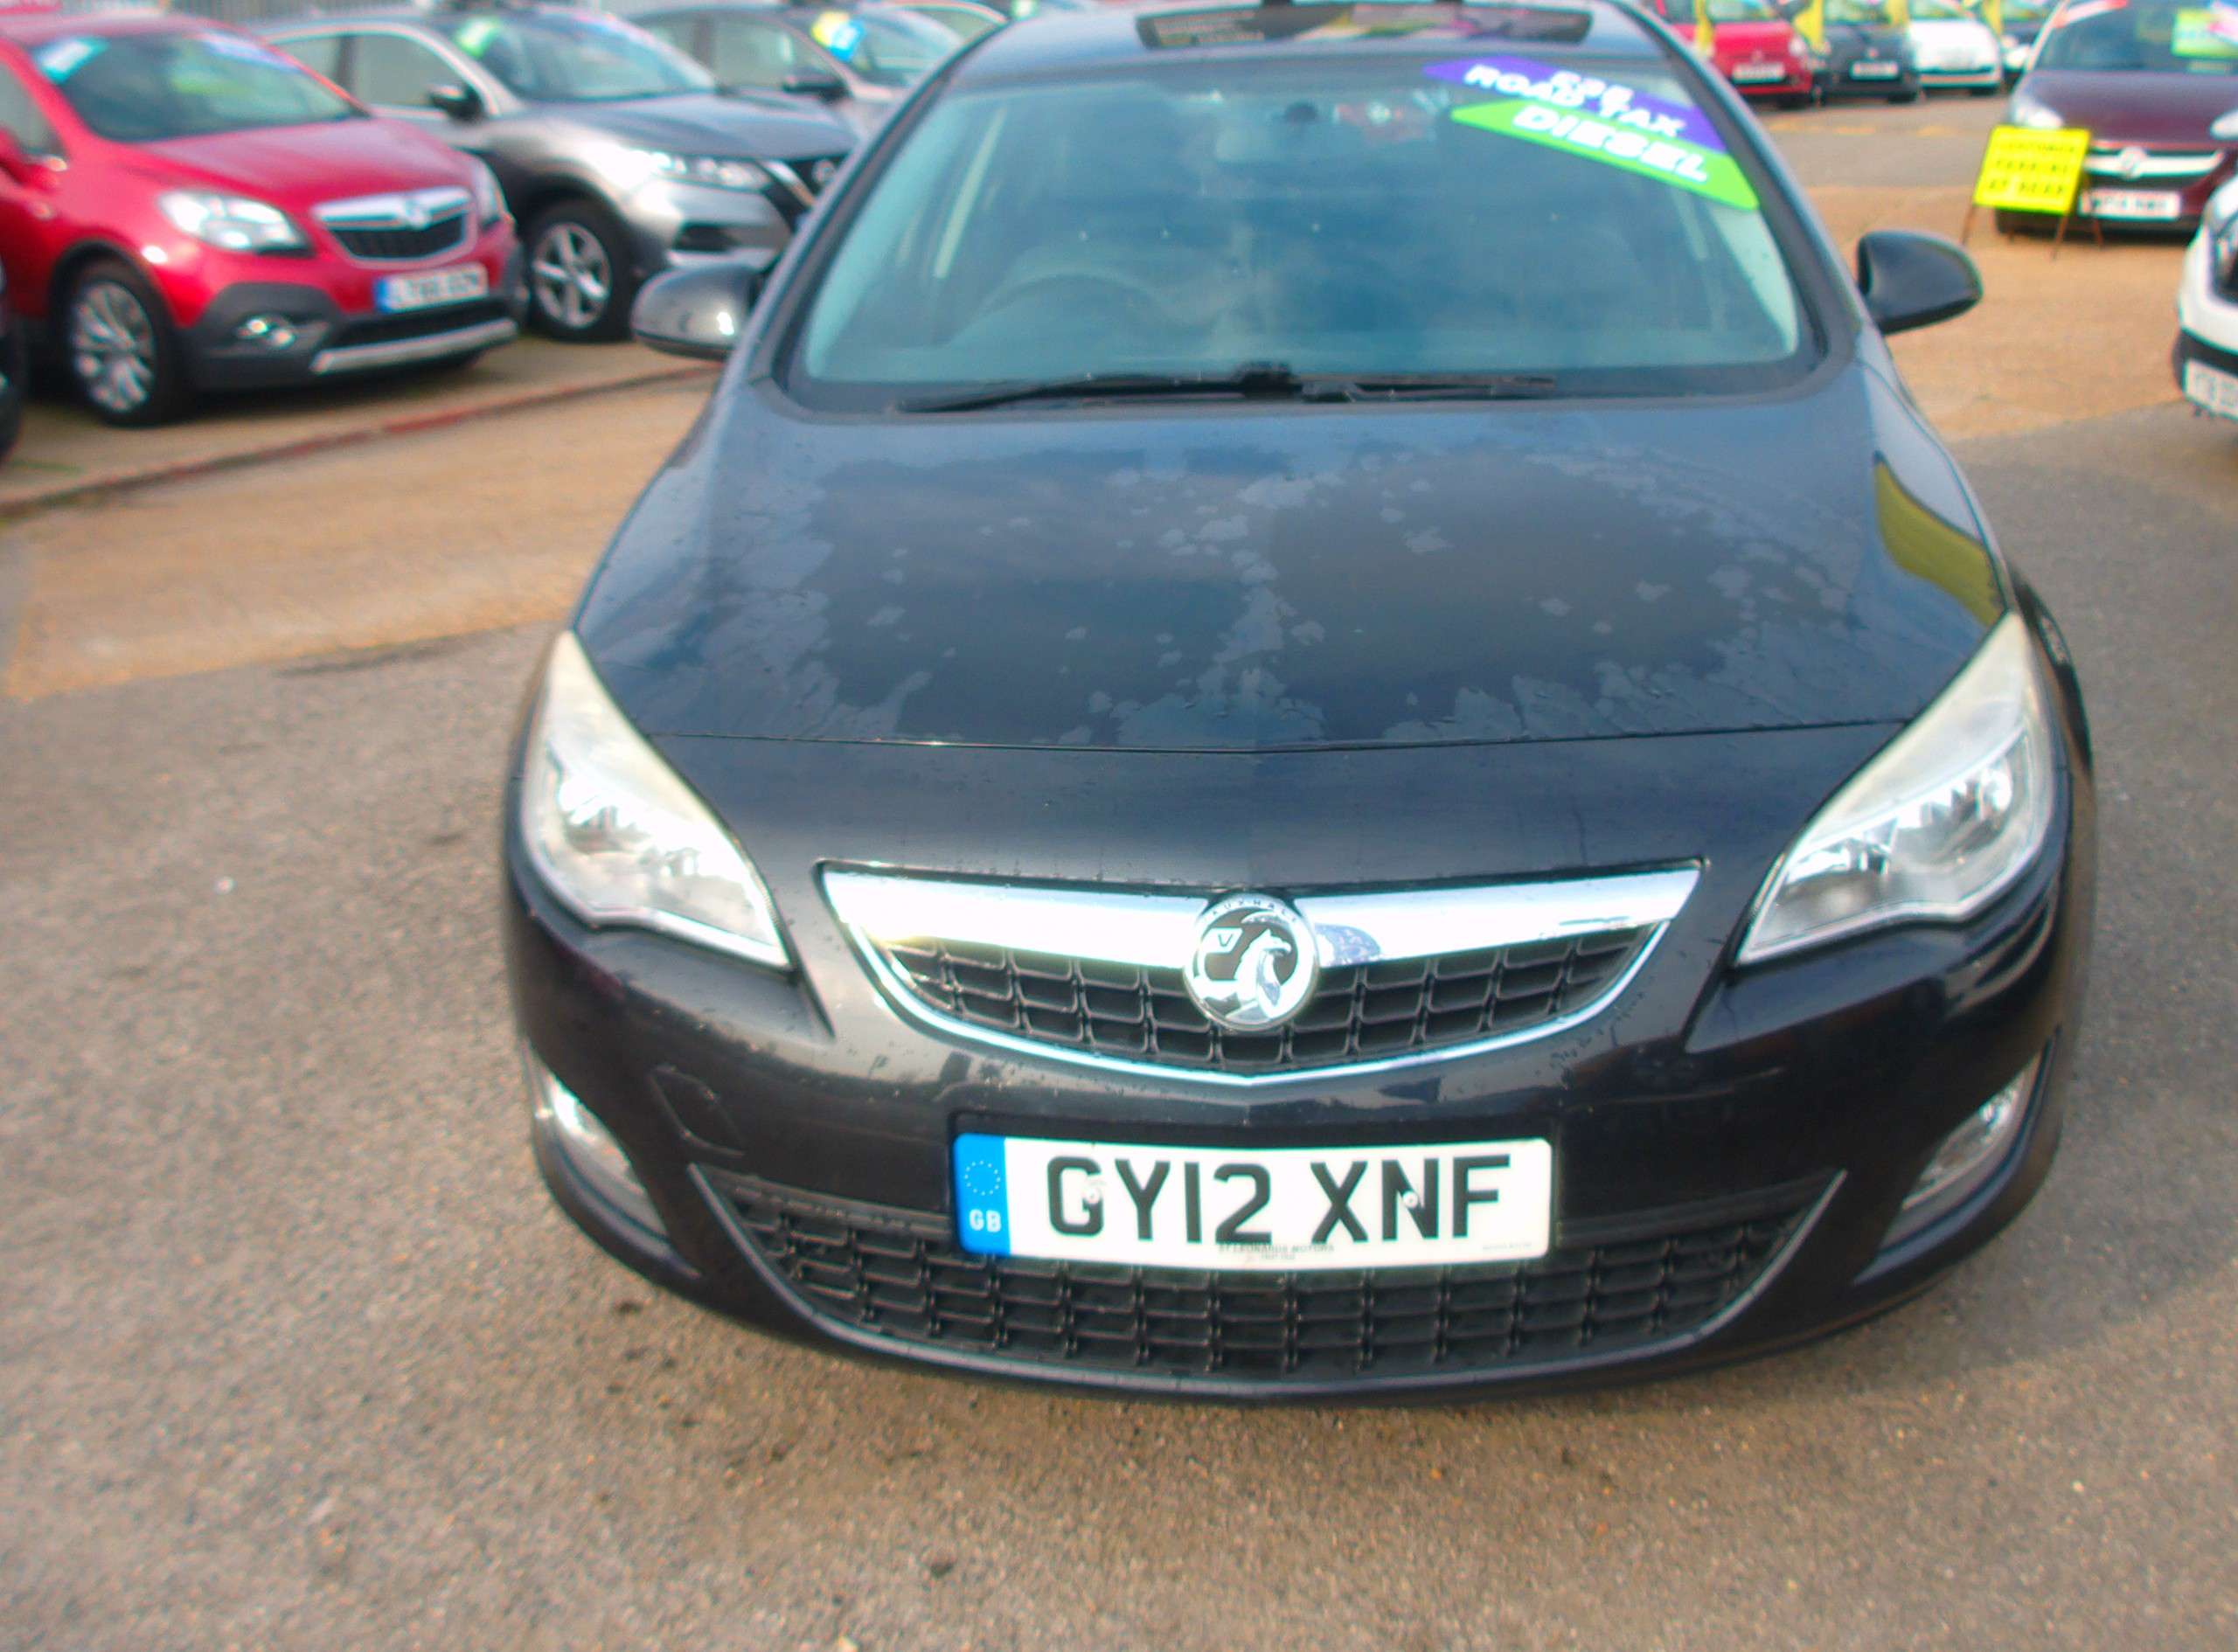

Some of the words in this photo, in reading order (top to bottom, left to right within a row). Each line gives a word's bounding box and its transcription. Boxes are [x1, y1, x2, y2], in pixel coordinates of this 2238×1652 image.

[1512, 104, 1707, 183] DIESEL
[1599, 99, 1685, 137] TAX
[969, 1208, 1003, 1233] GB
[1046, 1156, 1273, 1244] GY12
[1310, 1153, 1512, 1244] XNF
